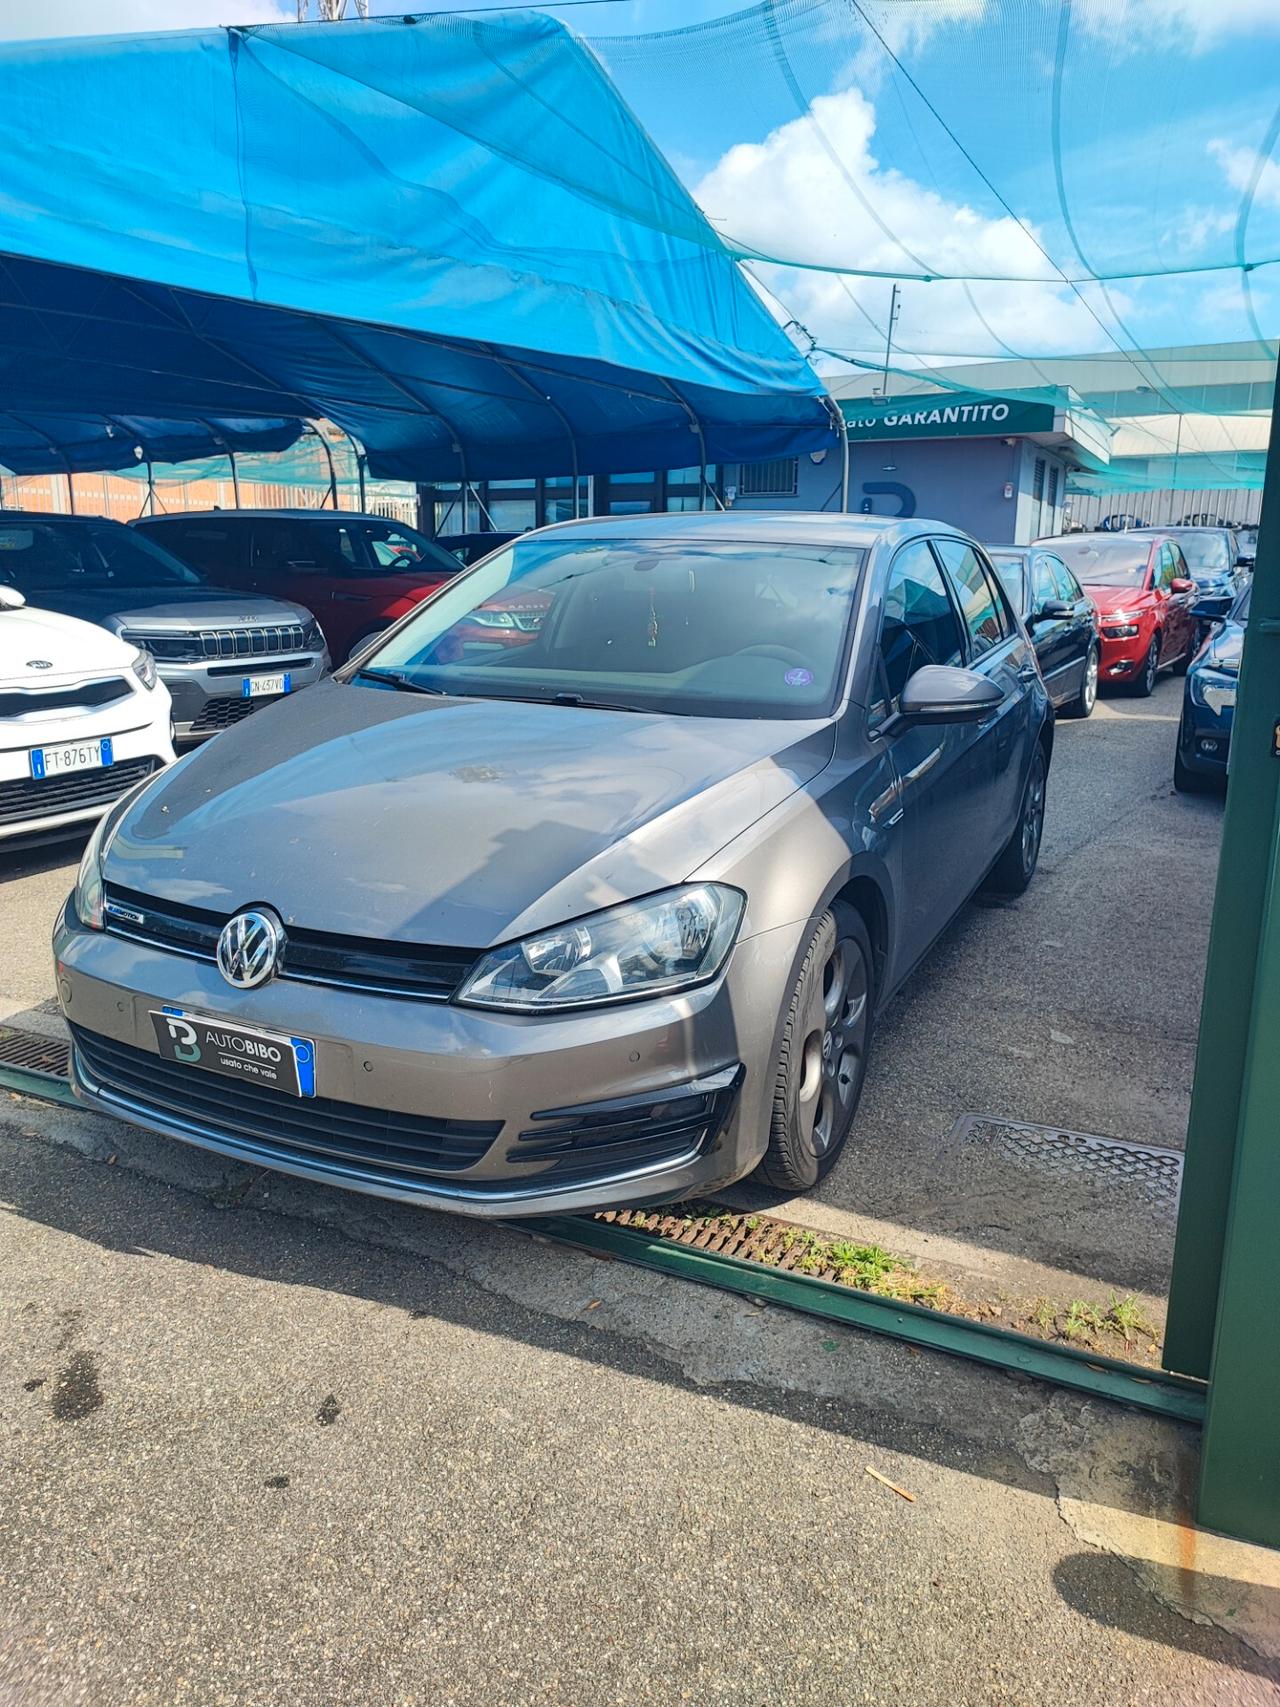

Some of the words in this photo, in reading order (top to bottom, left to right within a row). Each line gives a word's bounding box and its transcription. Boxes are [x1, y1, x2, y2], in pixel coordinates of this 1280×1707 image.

[883, 404, 1009, 427] GARANTITO
[206, 1031, 281, 1062] AUTOBIBO
[220, 1057, 242, 1069] usato
[243, 1063, 259, 1074] che
[260, 1068, 277, 1080] vale
